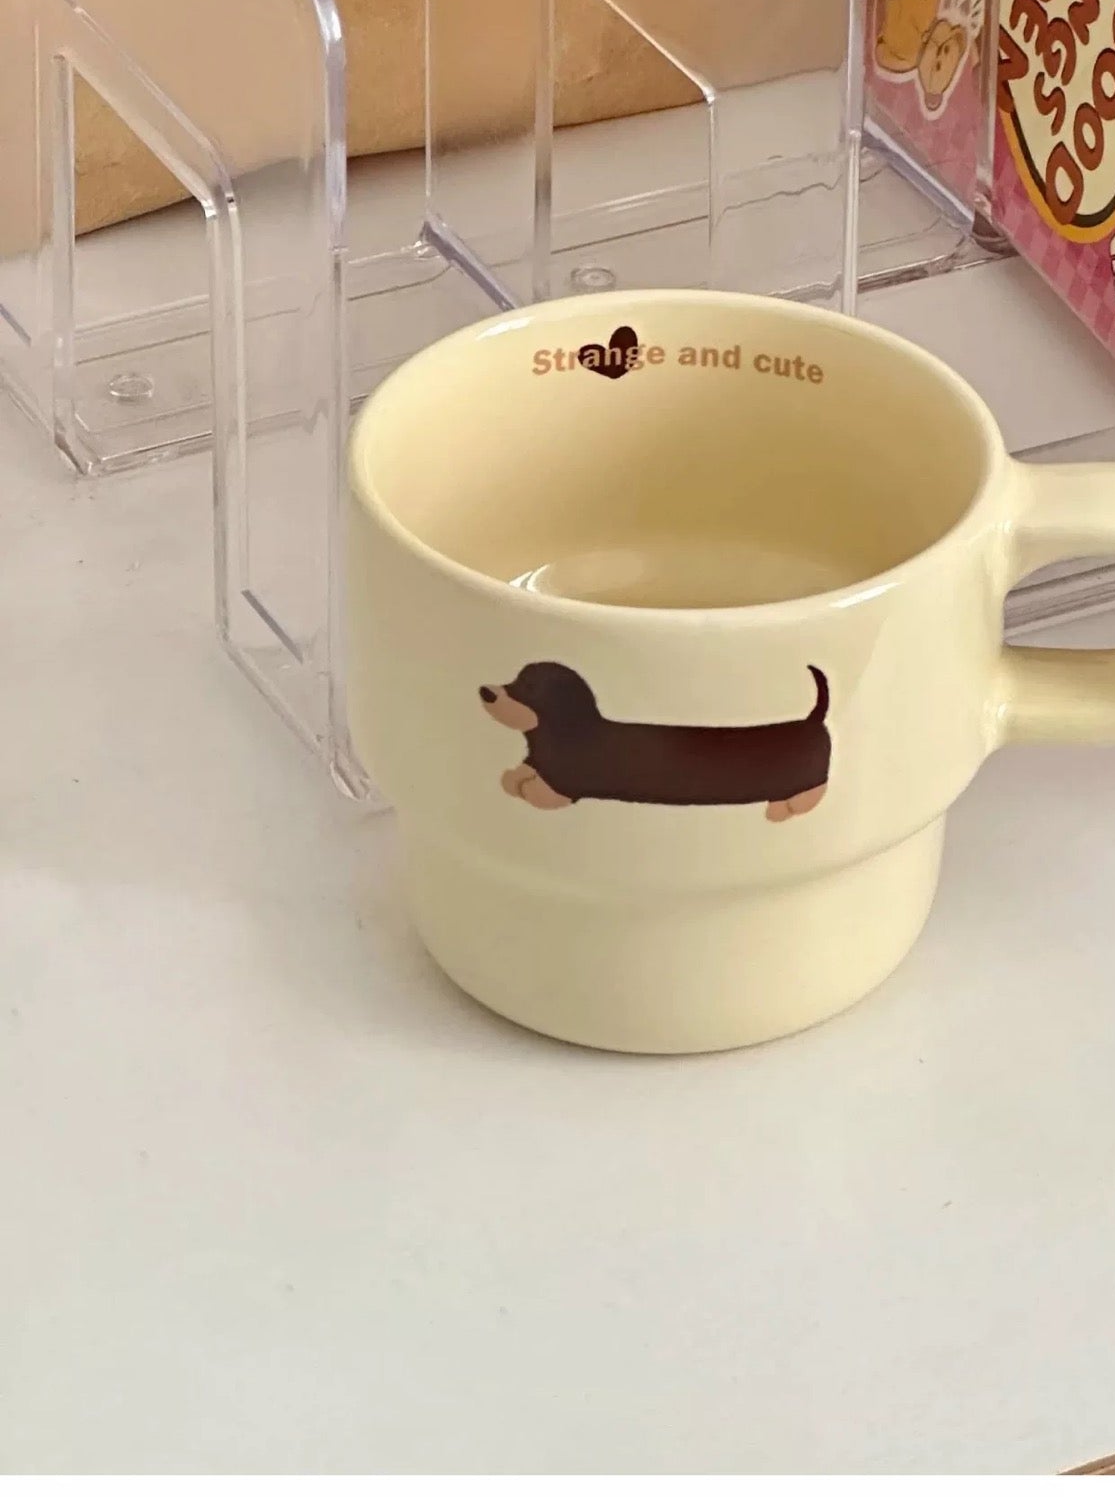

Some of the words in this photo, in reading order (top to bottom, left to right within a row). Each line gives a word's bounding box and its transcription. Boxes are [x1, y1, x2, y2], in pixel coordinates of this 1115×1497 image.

[532, 344, 666, 376] Strange
[678, 345, 741, 370] and
[753, 353, 824, 384] cute
